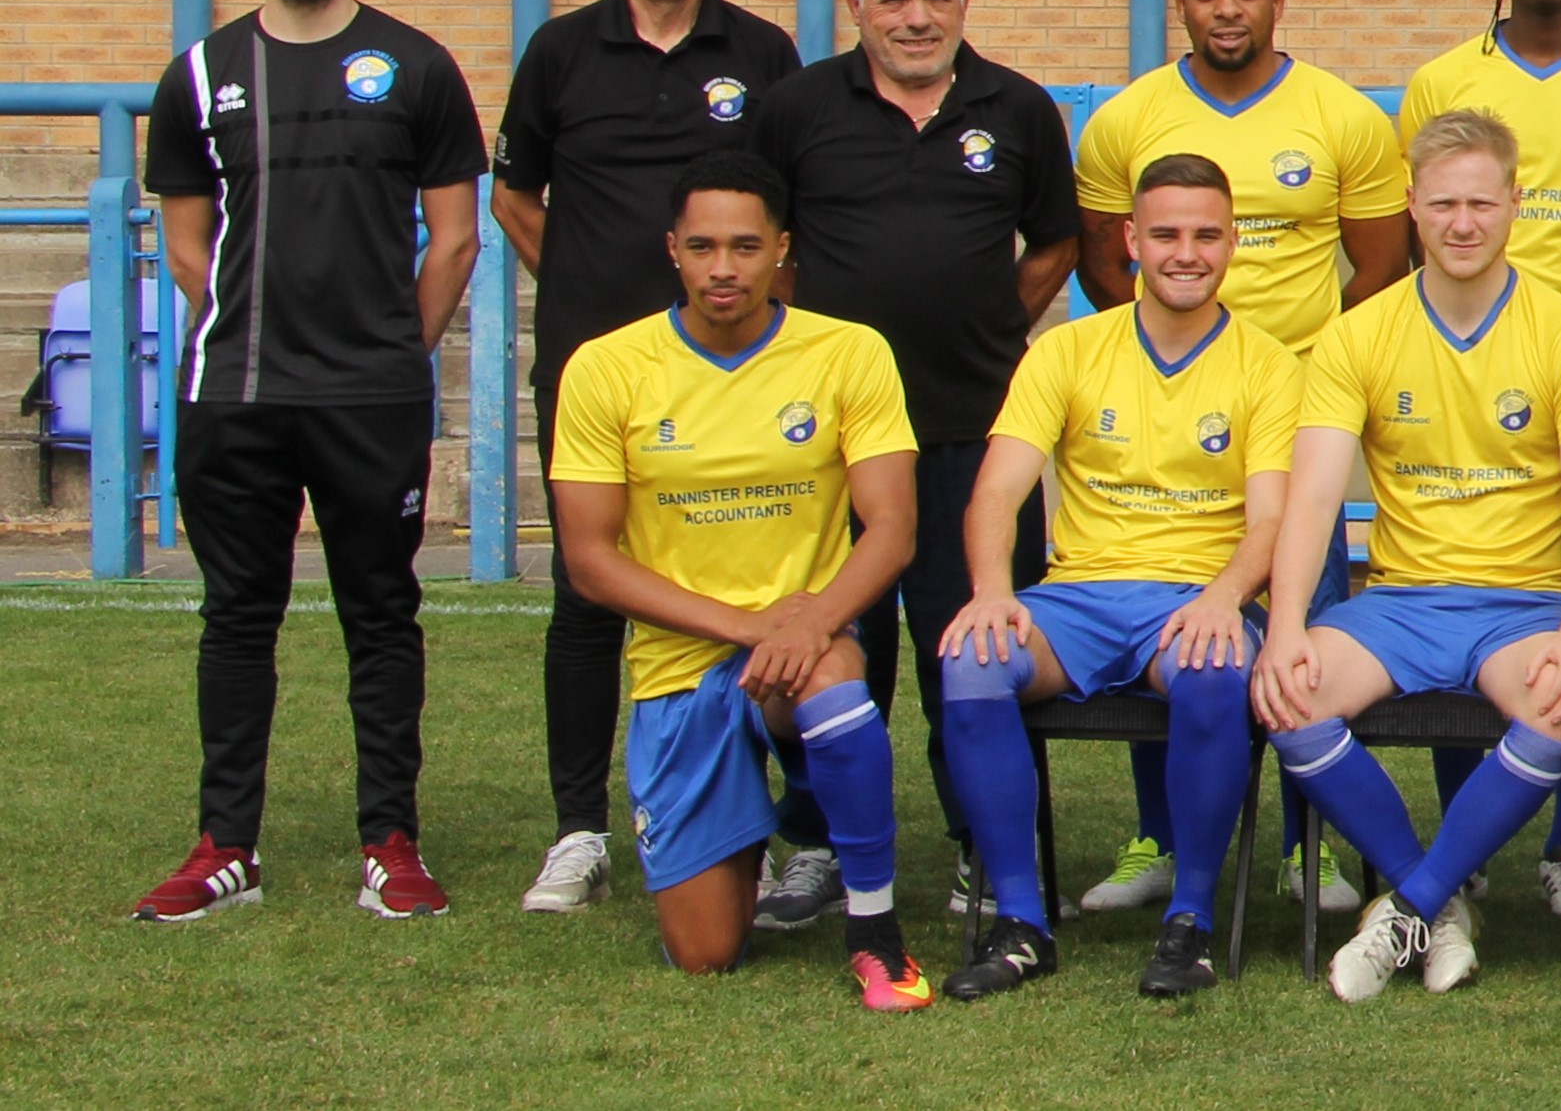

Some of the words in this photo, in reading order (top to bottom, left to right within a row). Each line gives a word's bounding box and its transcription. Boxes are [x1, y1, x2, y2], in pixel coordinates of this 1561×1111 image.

[1395, 462, 1464, 481] BANNISTER
[1468, 466, 1535, 481] PRENTICE
[657, 487, 740, 506] BANNISTER
[745, 480, 816, 499] PRENTICE
[1165, 488, 1229, 503] PRENTICE
[685, 503, 792, 525] ACCOUNTANTS
